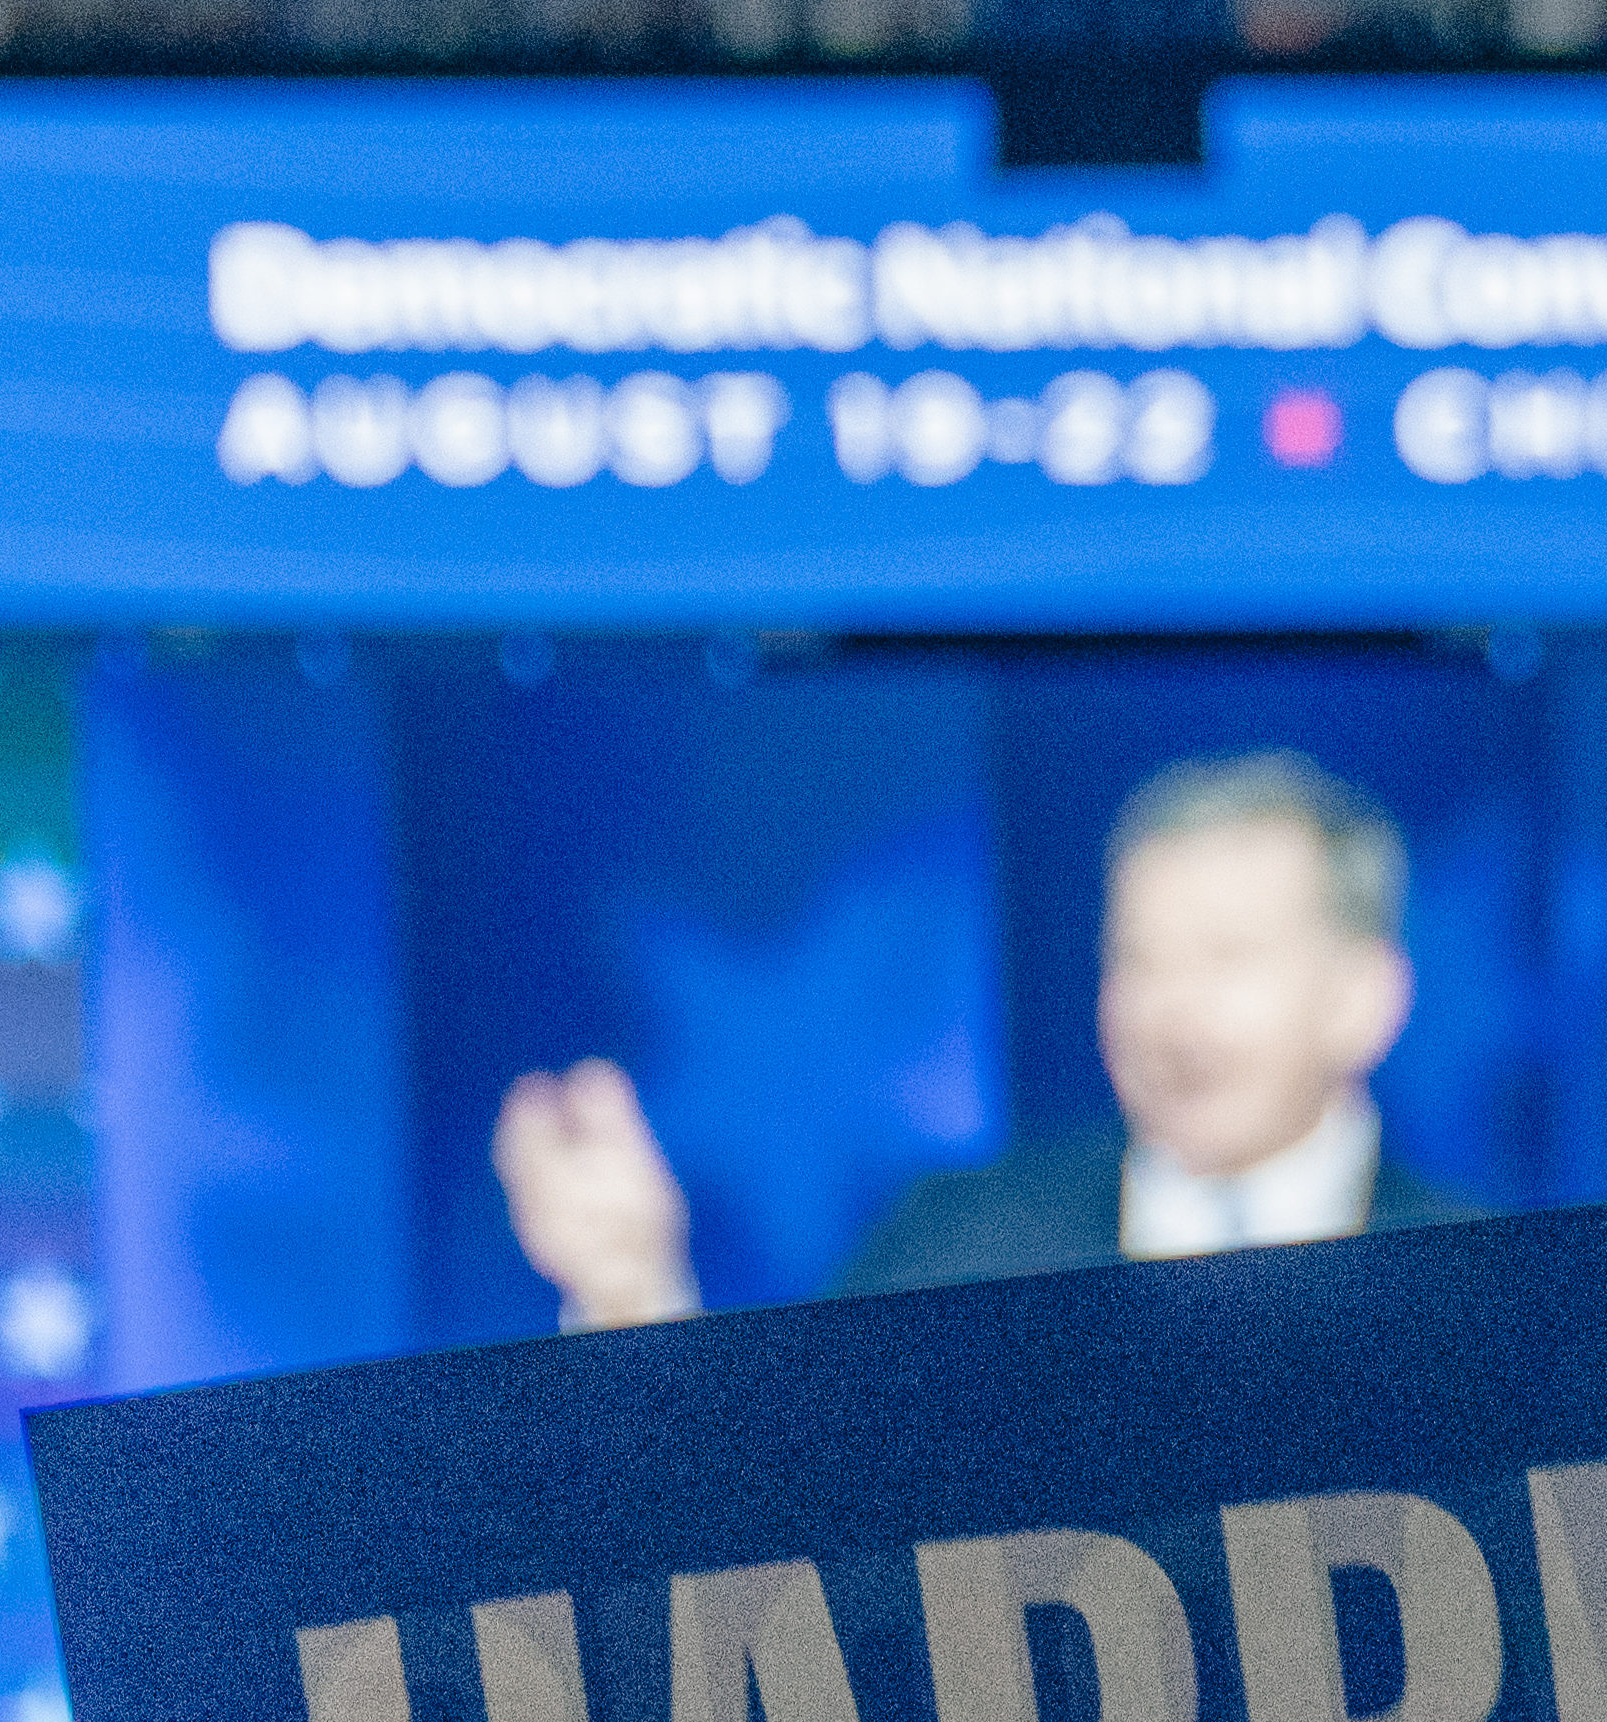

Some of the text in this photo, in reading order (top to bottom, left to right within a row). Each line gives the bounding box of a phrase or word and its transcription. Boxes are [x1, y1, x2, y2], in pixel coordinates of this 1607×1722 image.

[211, 218, 868, 351] Democratic
[873, 212, 1367, 348] National
[221, 370, 780, 486] AUGUST
[833, 368, 1211, 484] 19-22
